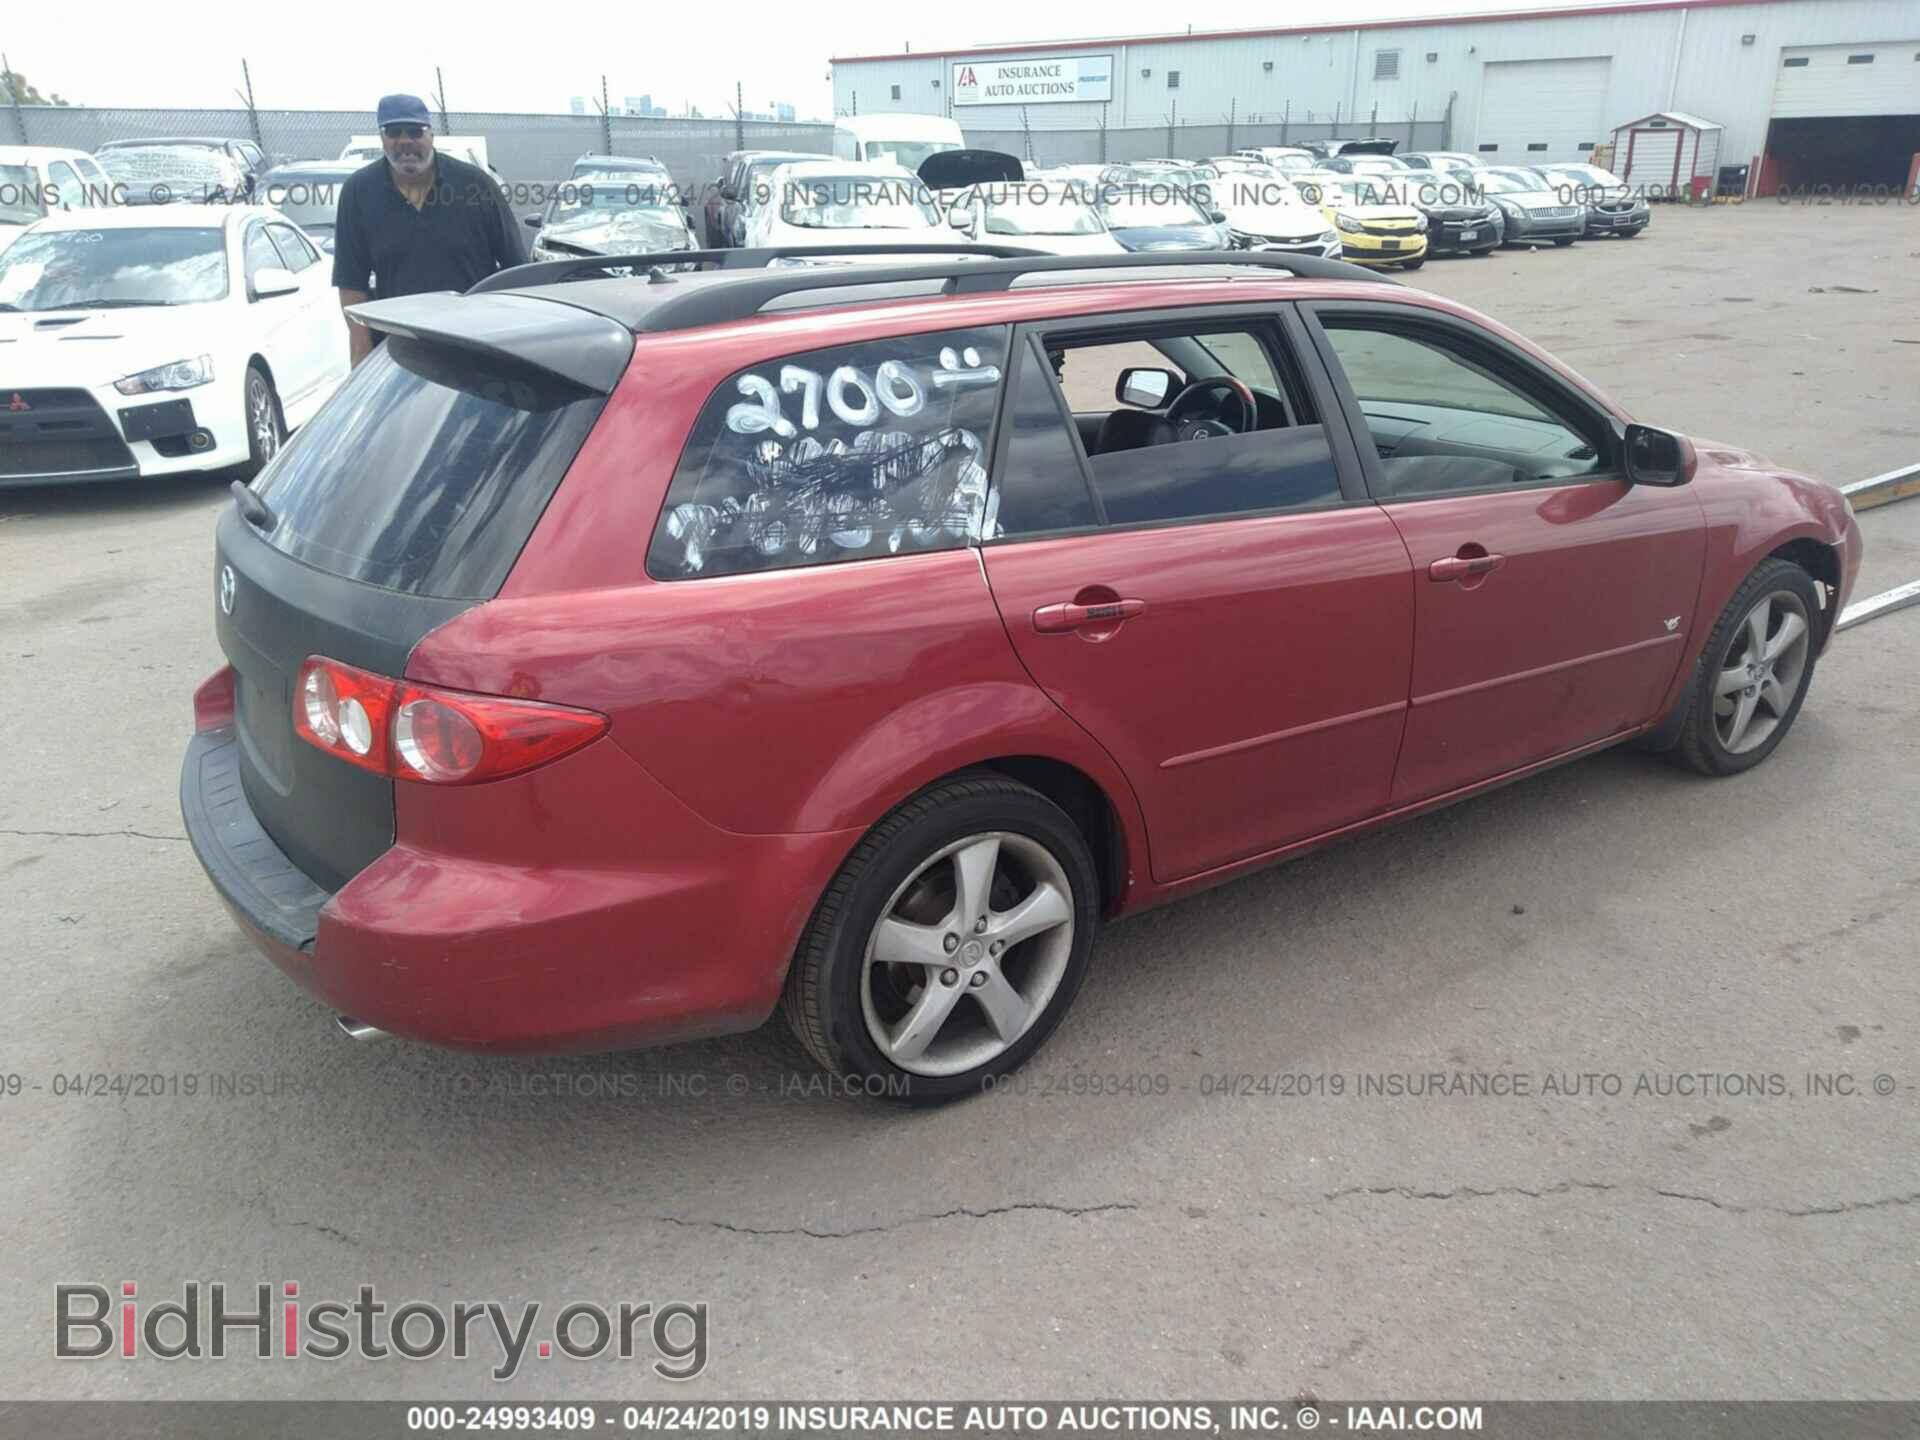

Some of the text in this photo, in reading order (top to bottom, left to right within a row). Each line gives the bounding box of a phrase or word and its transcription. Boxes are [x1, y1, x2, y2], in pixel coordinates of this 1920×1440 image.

[997, 64, 1062, 80] INSURANCE
[984, 84, 1015, 98] AUTO
[1017, 81, 1075, 97] AUCTIONS
